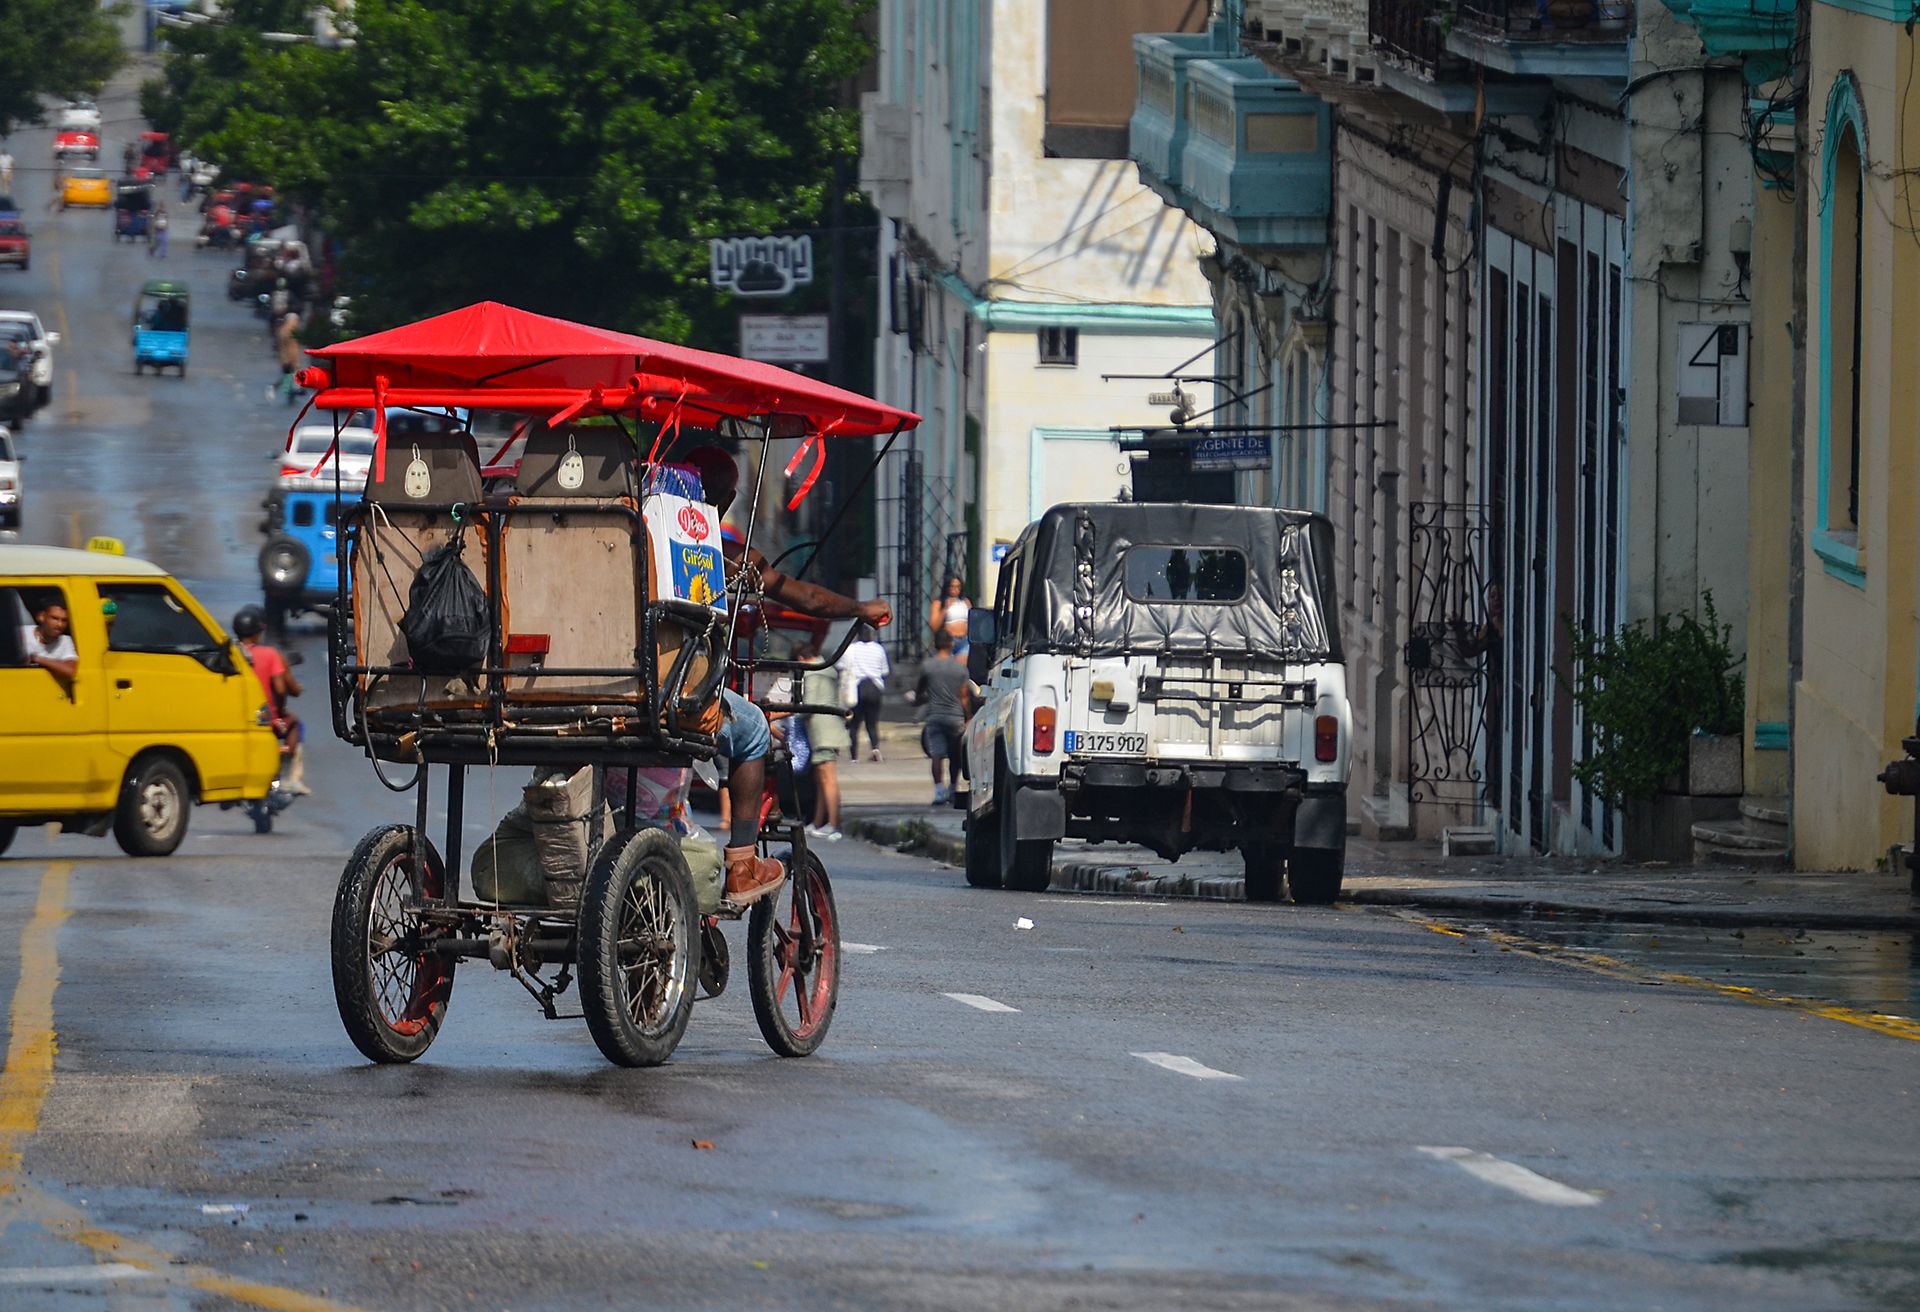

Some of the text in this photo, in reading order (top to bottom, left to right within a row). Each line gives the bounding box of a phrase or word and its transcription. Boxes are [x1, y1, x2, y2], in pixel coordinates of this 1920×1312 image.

[1196, 438, 1244, 450] AGENTE
[1076, 734, 1145, 752] B 175 902
